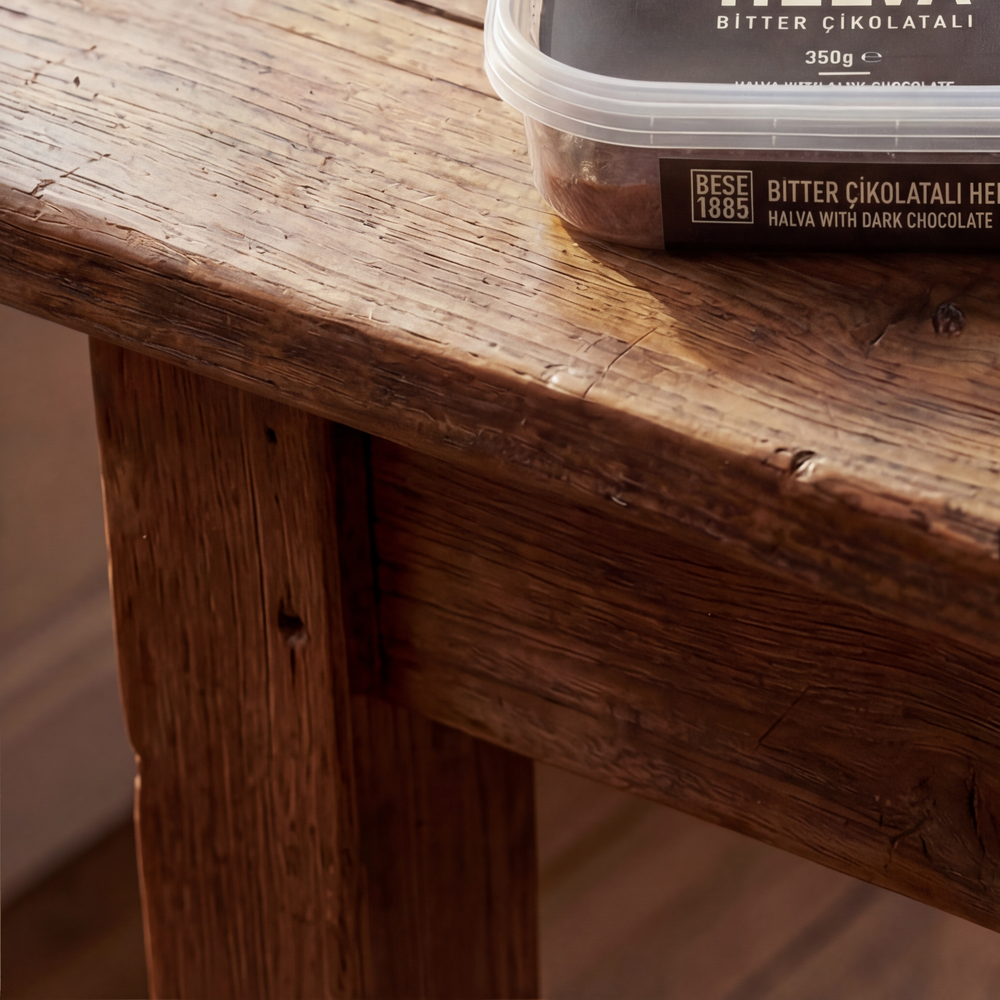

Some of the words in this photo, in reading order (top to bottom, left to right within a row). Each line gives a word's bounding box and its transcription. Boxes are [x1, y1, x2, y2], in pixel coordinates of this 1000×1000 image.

[716, 13, 808, 30] BİTTER
[822, 13, 974, 33] ÇİKOLATALI
[805, 50, 854, 67] 350g
[696, 174, 749, 196] BESE
[767, 177, 839, 203] BİTTER
[845, 176, 962, 209] ÇİKOLATALI
[696, 196, 750, 219] 1885
[768, 210, 816, 227] HALVA
[819, 211, 857, 228] WITH
[862, 211, 903, 228] DARK
[906, 211, 994, 229] CHOCOLATE
